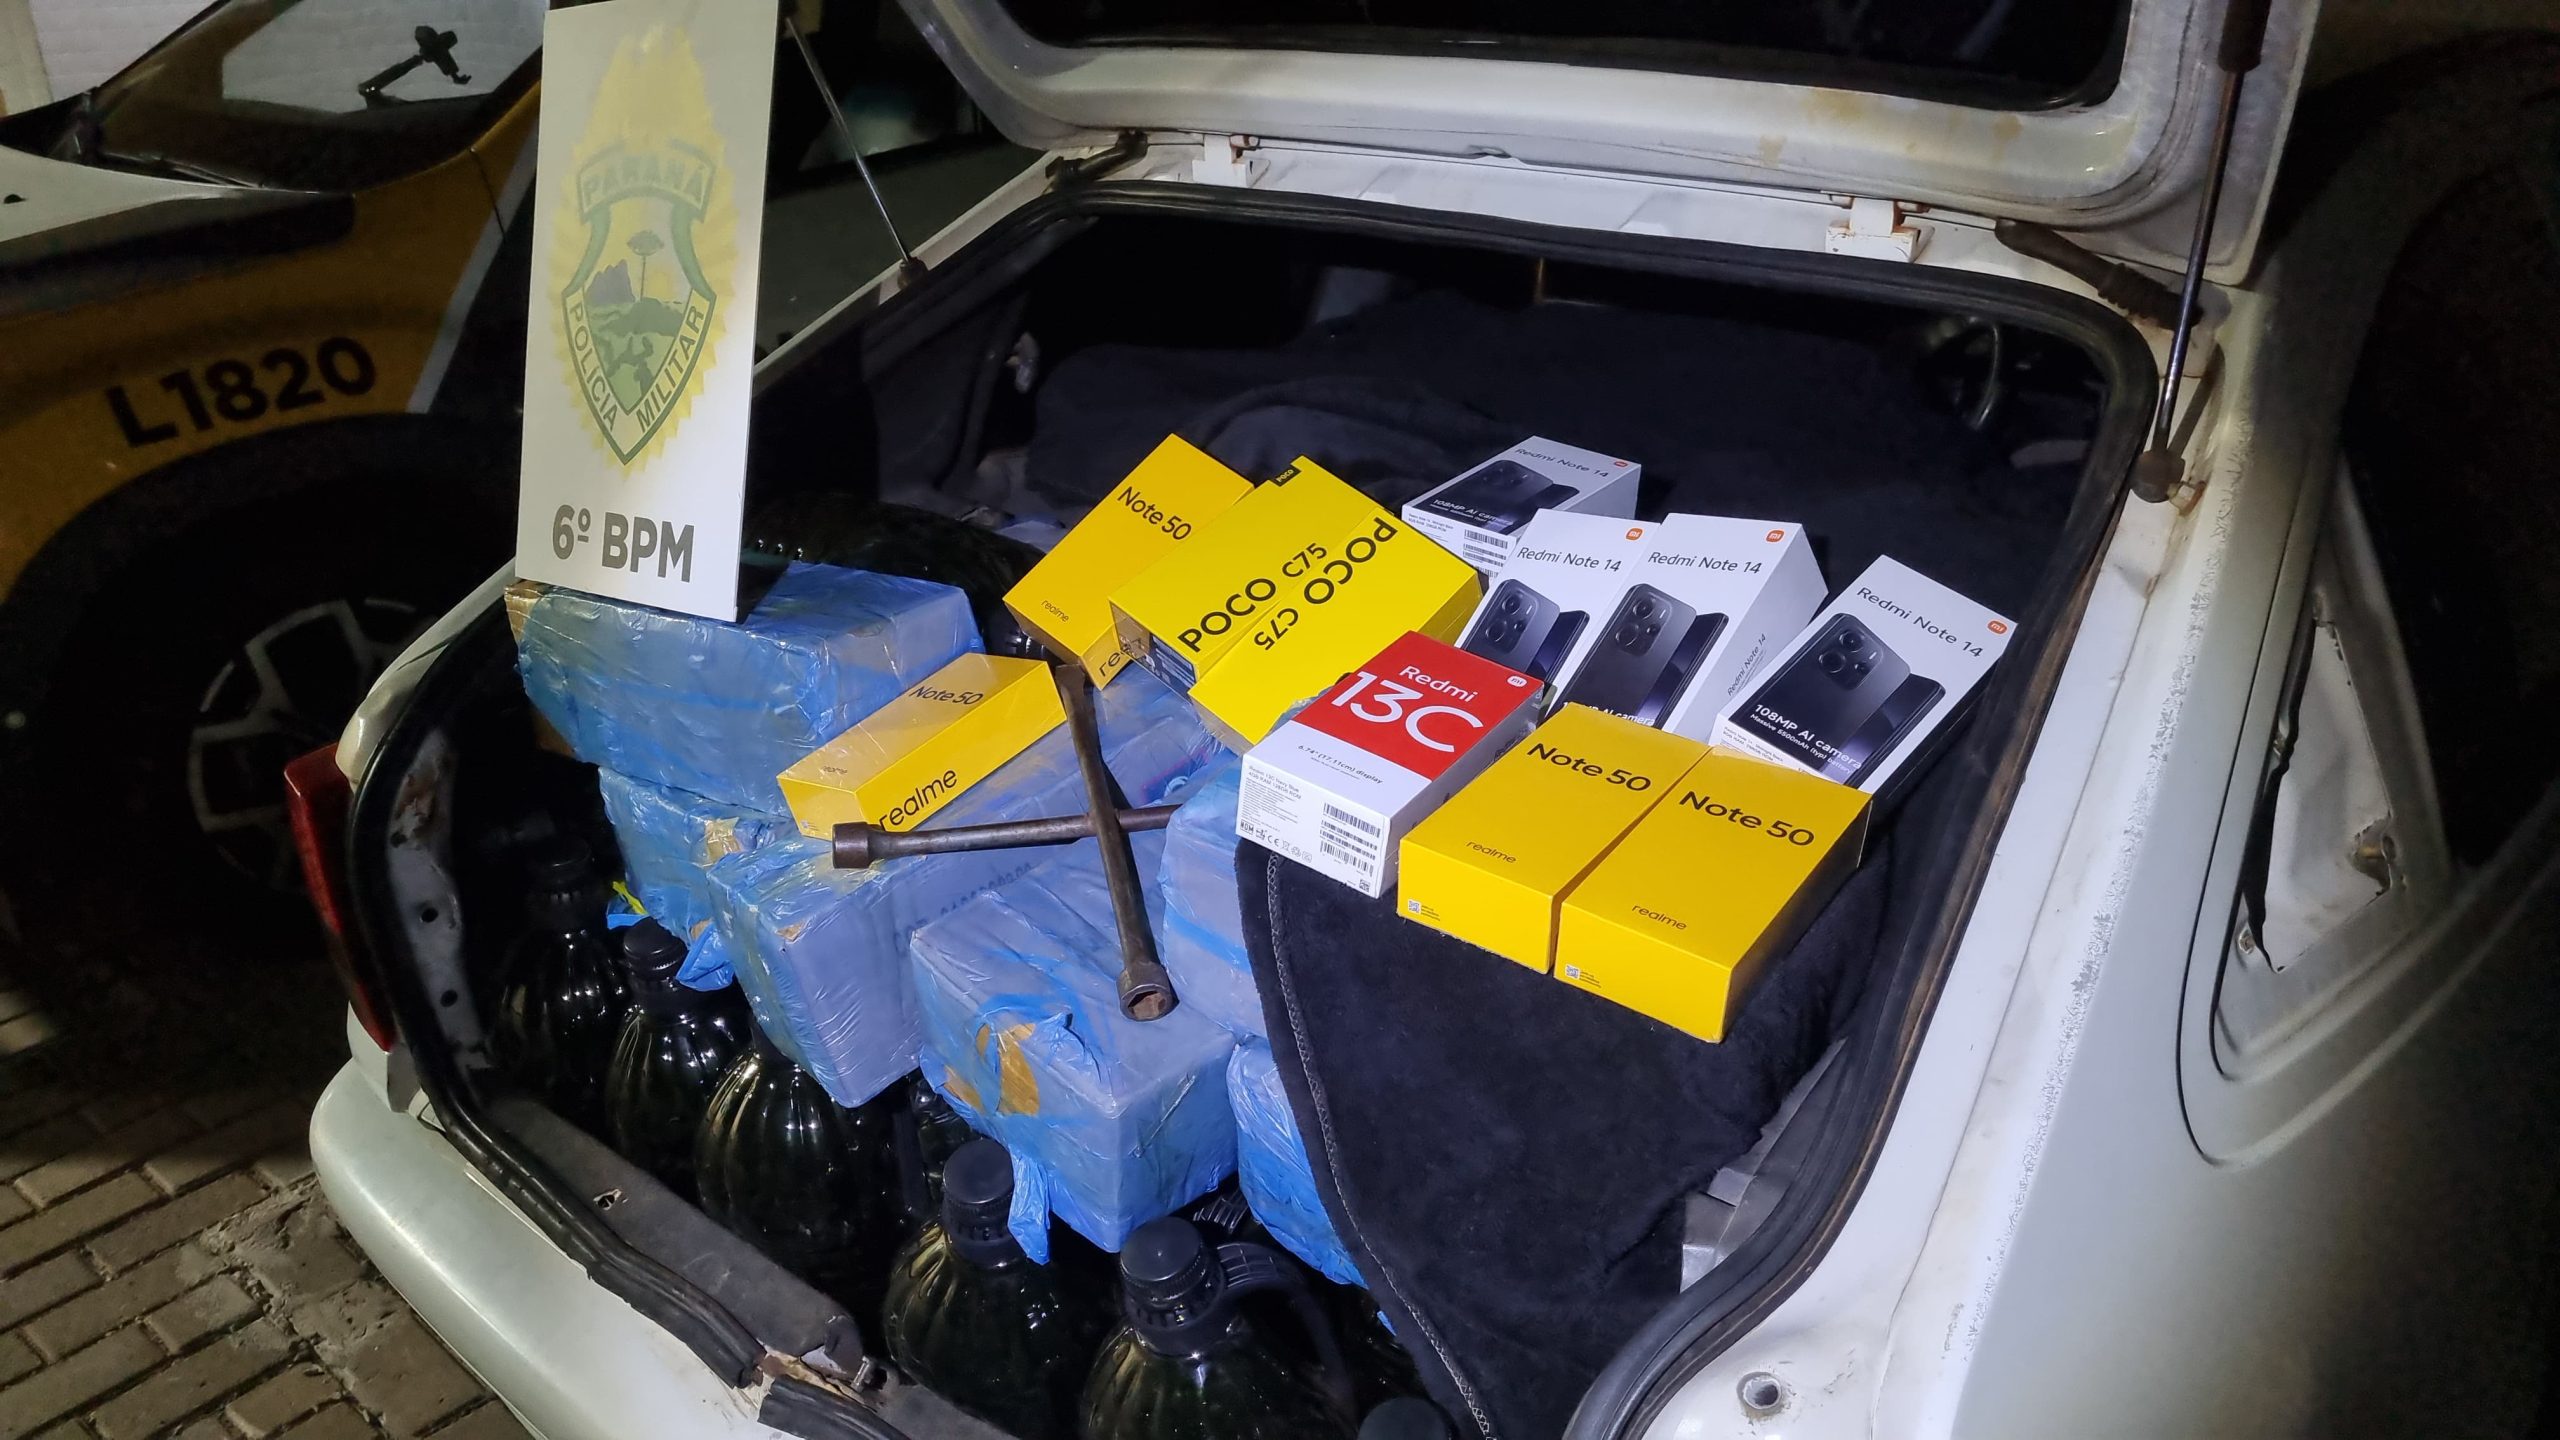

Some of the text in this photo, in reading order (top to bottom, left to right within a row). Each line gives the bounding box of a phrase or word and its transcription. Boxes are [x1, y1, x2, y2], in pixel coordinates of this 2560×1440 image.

[104, 337, 377, 448] L1820
[636, 305, 704, 433] MILITAR
[1275, 469, 1294, 483] POCO
[1515, 448, 1609, 478] Redmi Note 14
[1117, 486, 1192, 541] Note 50
[602, 512, 695, 583] BPM
[1517, 547, 1622, 573] Redmi Note 14
[1648, 551, 1762, 574] Redmi Note 14
[1178, 542, 1328, 652] POCO C75
[1253, 517, 1398, 651] POCO C75
[1040, 599, 1070, 624] realme
[1857, 586, 1984, 659] Redmi Note 14
[1398, 665, 1479, 703] Redmi
[1728, 667, 1746, 696] Redmi
[1744, 646, 1759, 669] Note
[1758, 633, 1766, 646] 14
[908, 686, 984, 705] Note 50
[1331, 671, 1484, 753] 13C
[1750, 713, 1777, 731] Massive
[1777, 729, 1810, 751] 5500mAh
[1809, 746, 1827, 760] (typ)
[1755, 704, 1798, 731] 108MP
[1797, 730, 1815, 742] AI
[1815, 740, 1862, 769] camera
[1355, 769, 1384, 784] display
[1527, 743, 1651, 793] Note 50
[878, 769, 958, 832] realme
[1679, 791, 1816, 848] Note 50
[1466, 840, 1517, 865] realme
[1631, 904, 1688, 932] realme
